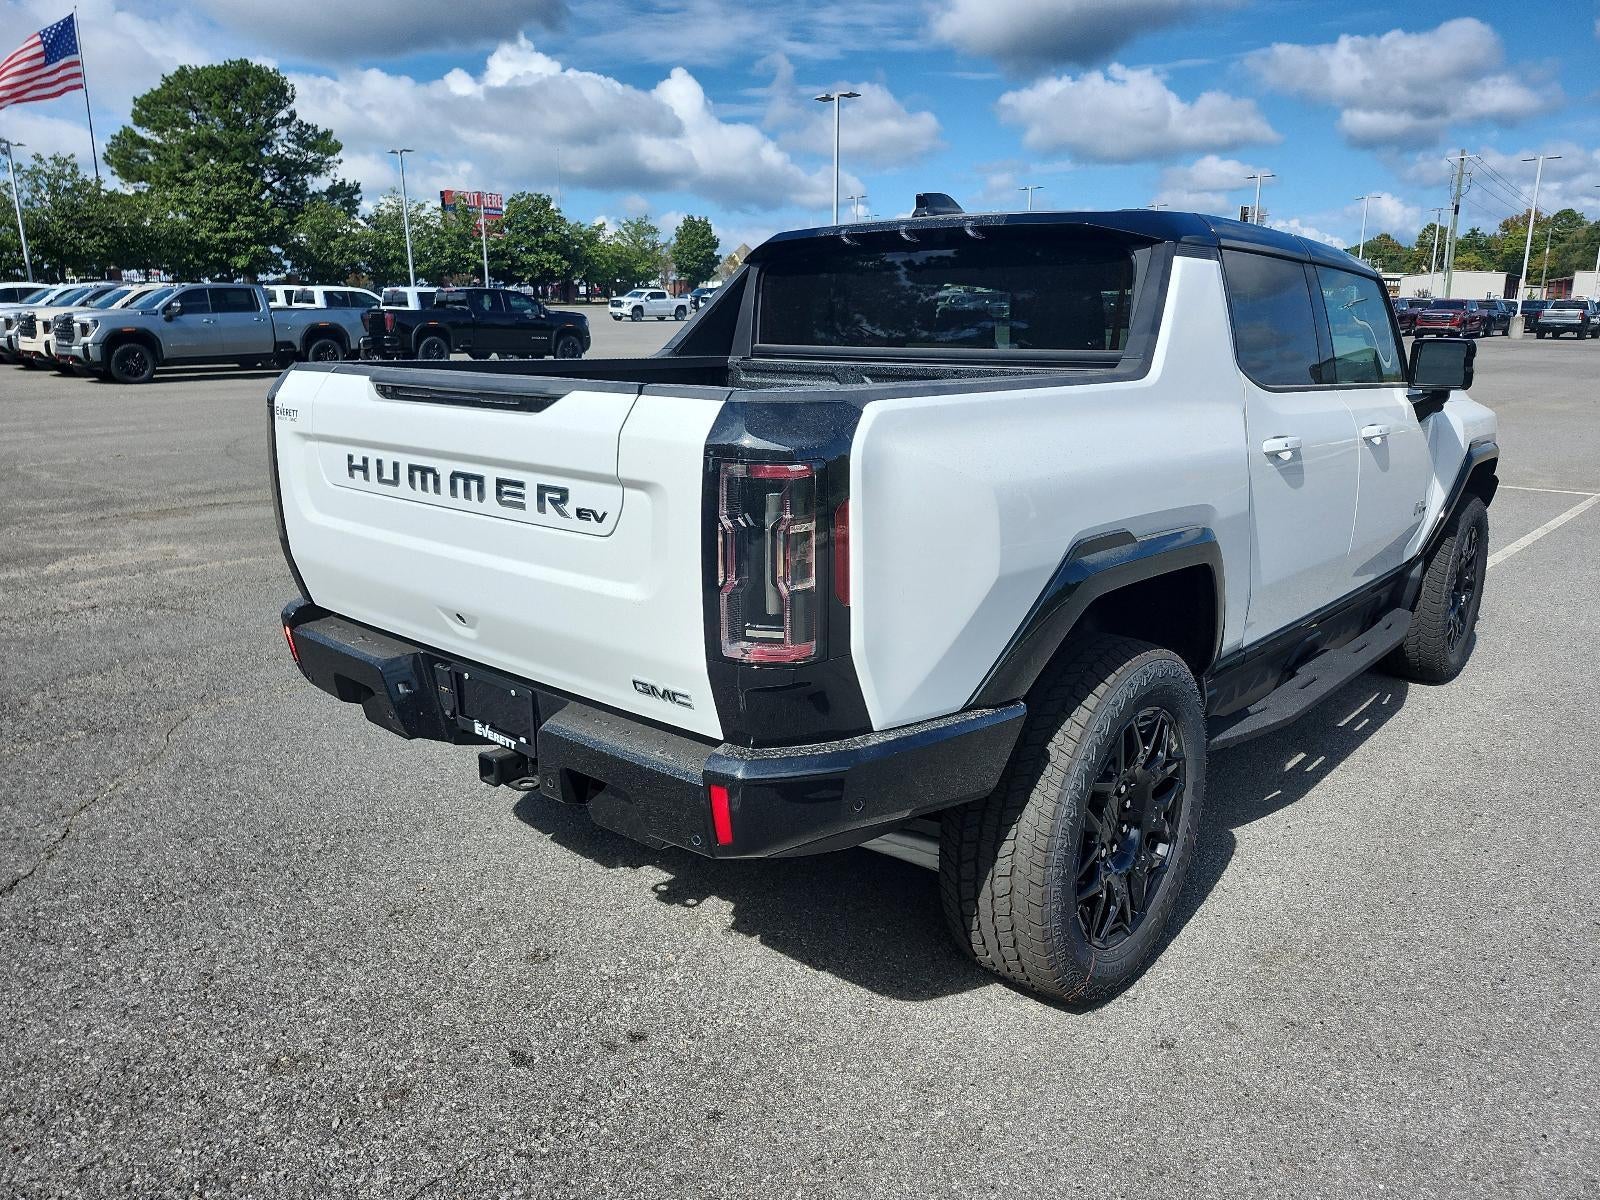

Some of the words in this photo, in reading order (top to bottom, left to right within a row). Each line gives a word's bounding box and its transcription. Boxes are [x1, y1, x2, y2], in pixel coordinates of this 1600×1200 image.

[347, 453, 573, 520] HUMMER
[576, 506, 608, 524] EV
[632, 679, 695, 710] GMC
[474, 720, 517, 750] EVERETT
